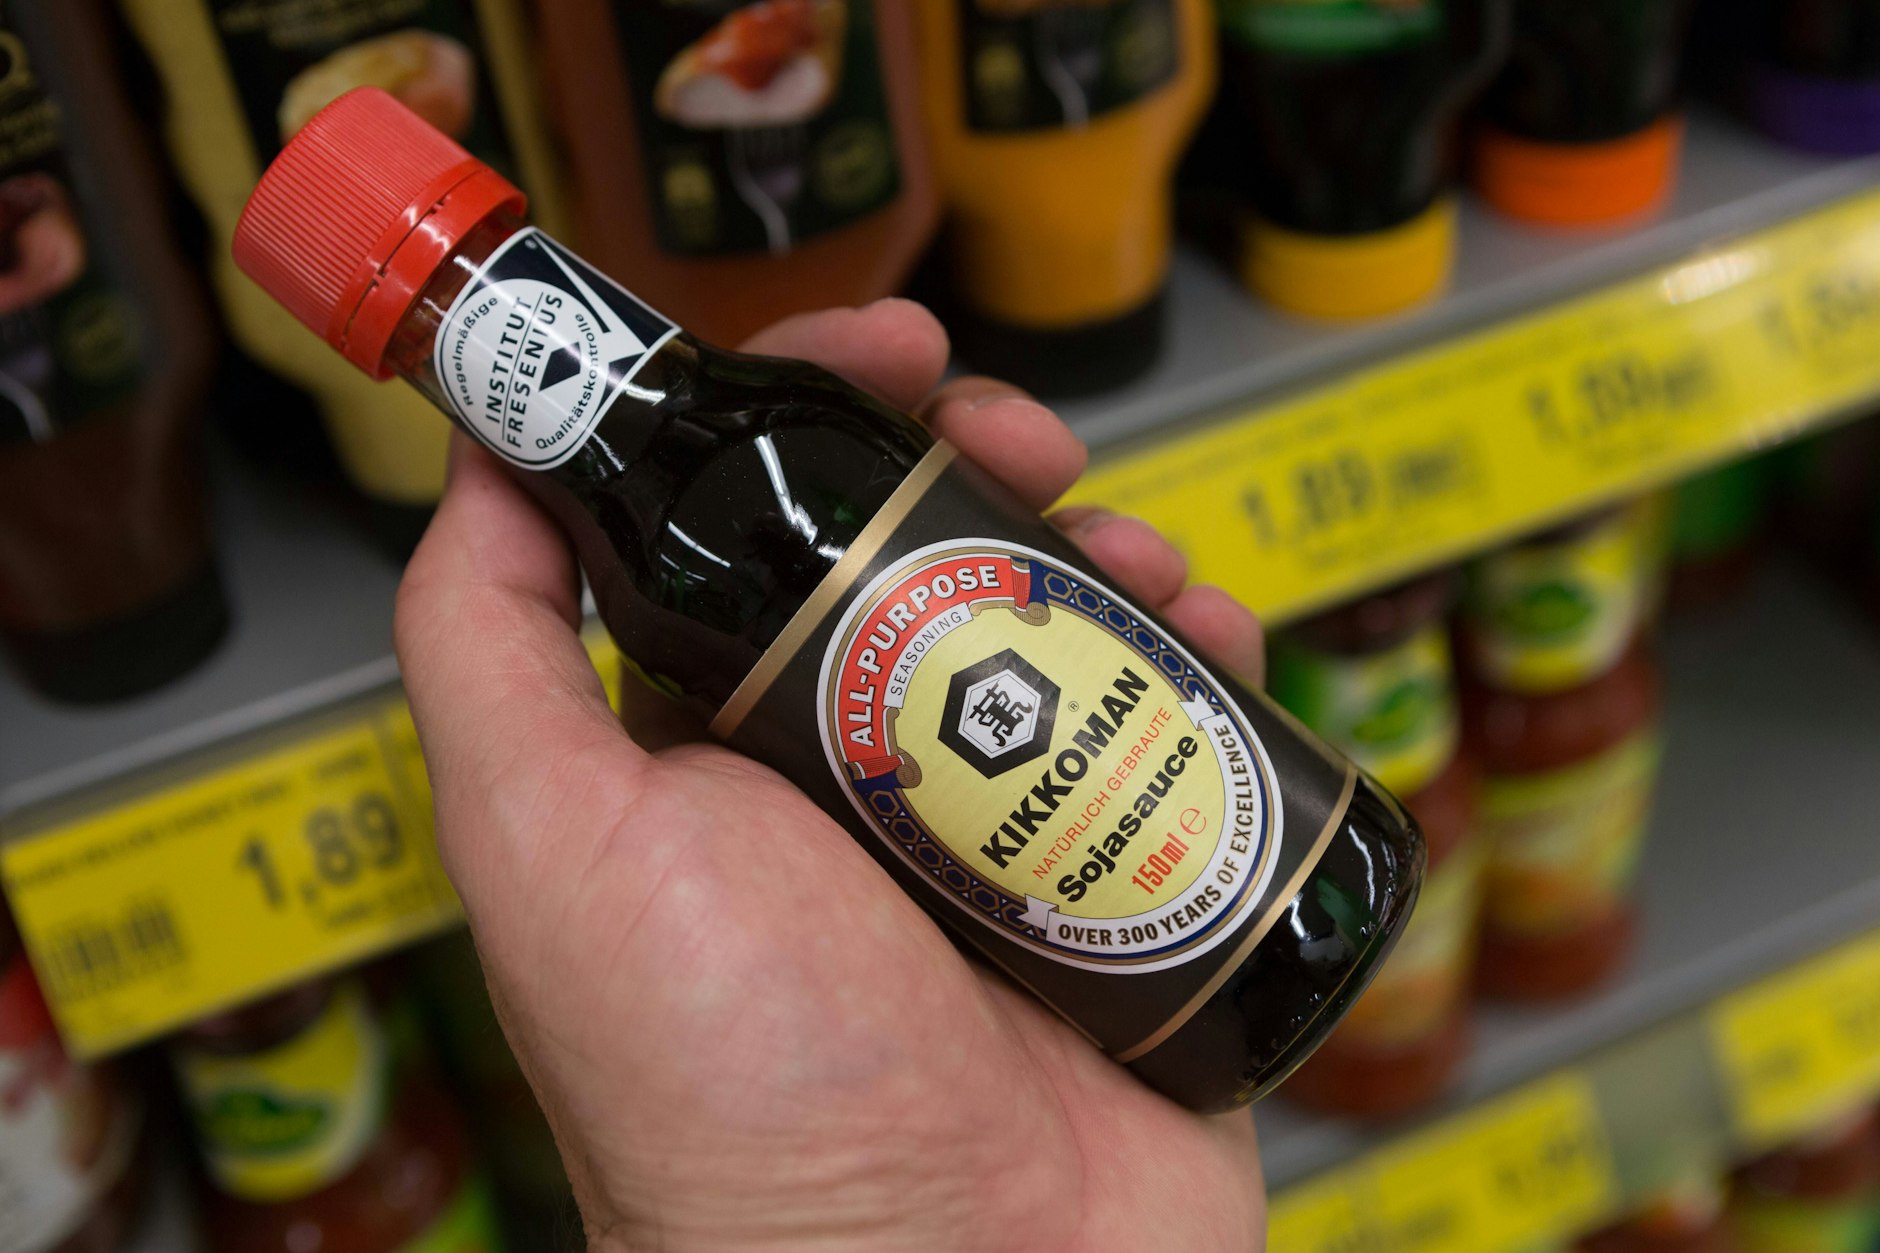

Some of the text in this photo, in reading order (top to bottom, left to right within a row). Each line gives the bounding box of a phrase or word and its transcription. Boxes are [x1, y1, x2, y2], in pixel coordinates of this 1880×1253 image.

[451, 296, 498, 406] Regelmäßige
[485, 297, 532, 423] INSTITUT
[507, 294, 563, 448] FRESENIUS
[535, 314, 599, 450] Qualitätskontrolle
[849, 565, 1000, 747] ALL-PURPOSE
[890, 611, 962, 695] SEASONING
[980, 666, 1150, 869] KIKKOMAN
[1032, 707, 1172, 879] NATÜRLICH GEBRAUTE
[1057, 735, 1198, 903] Sojasauce
[1058, 722, 1254, 946] OVER 300 YEARS OF EXCELLENCE
[1131, 834, 1190, 895] 150ml
